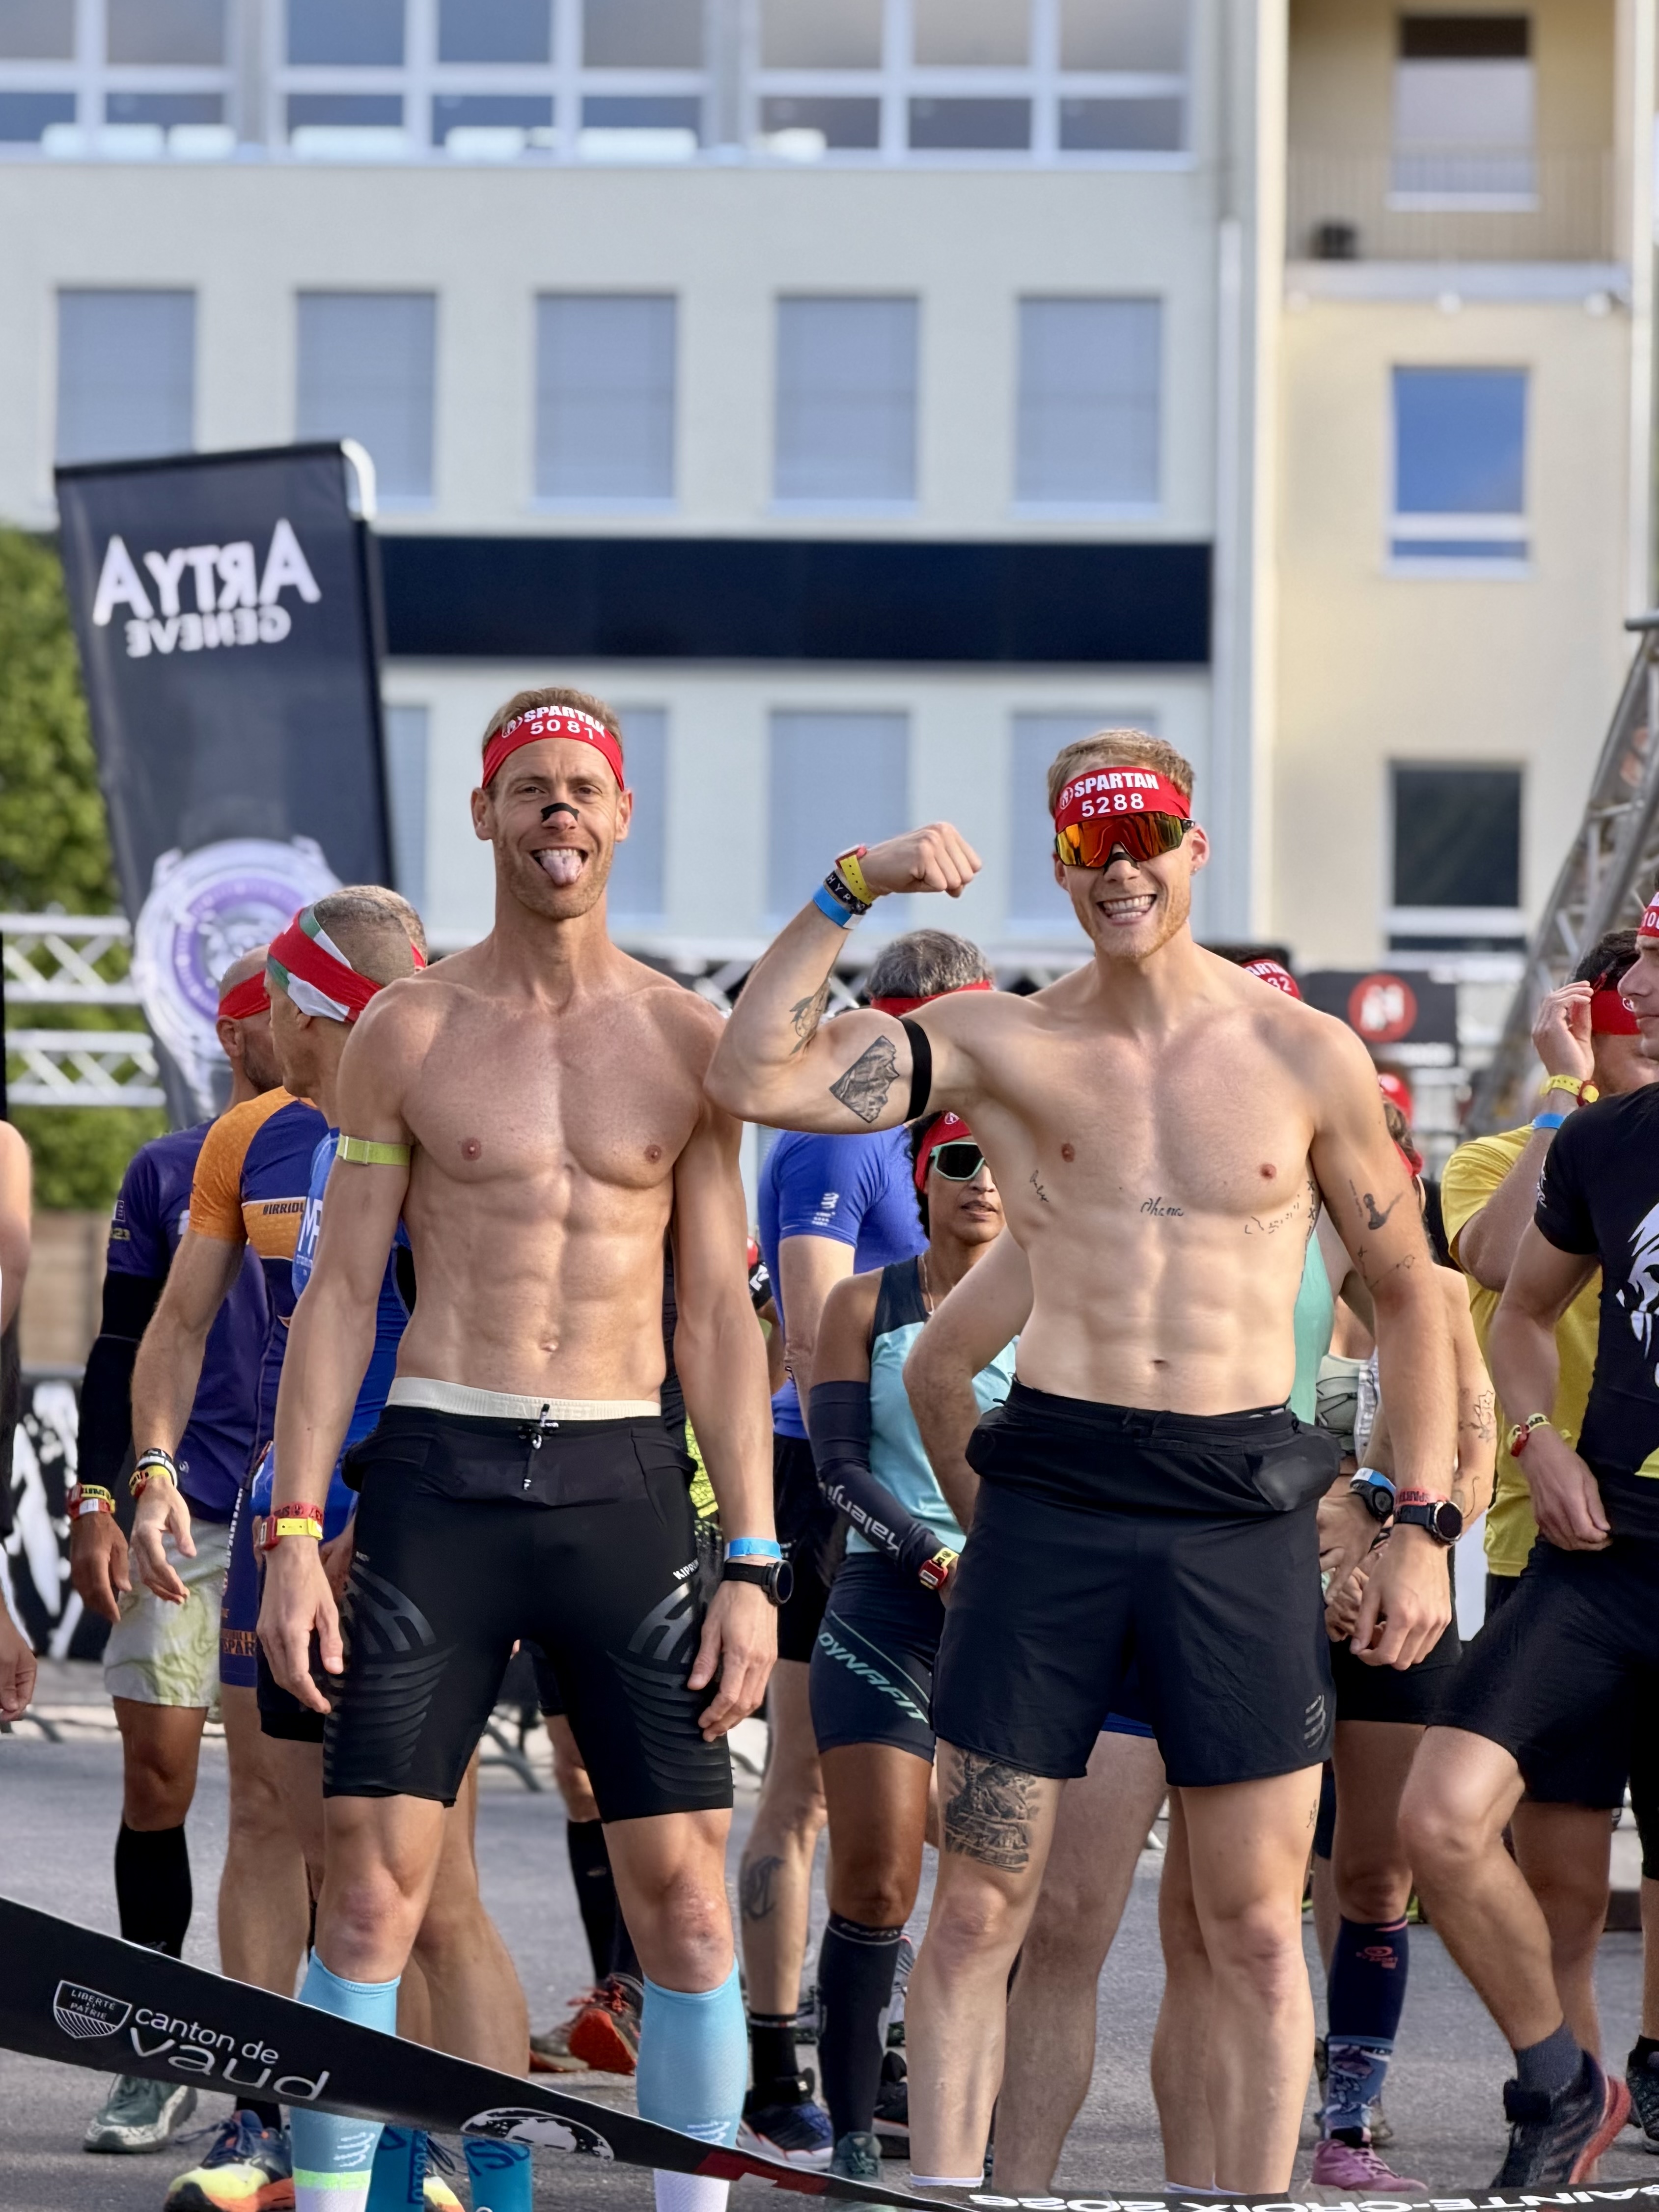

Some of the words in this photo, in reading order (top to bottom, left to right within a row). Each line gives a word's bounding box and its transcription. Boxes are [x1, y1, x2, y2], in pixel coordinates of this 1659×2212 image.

[524, 705, 606, 738] SPARTAN
[529, 719, 594, 740] 5081
[1074, 772, 1160, 798] SPARTAN
[1081, 793, 1145, 817] 5288
[1267, 976, 1292, 991] 32
[818, 1631, 929, 1724] DYNAFIT
[70, 2002, 108, 2020] PATRIE
[135, 2008, 235, 2051] canton
[241, 2040, 279, 2064] de
[969, 2194, 1169, 2212] 2026
